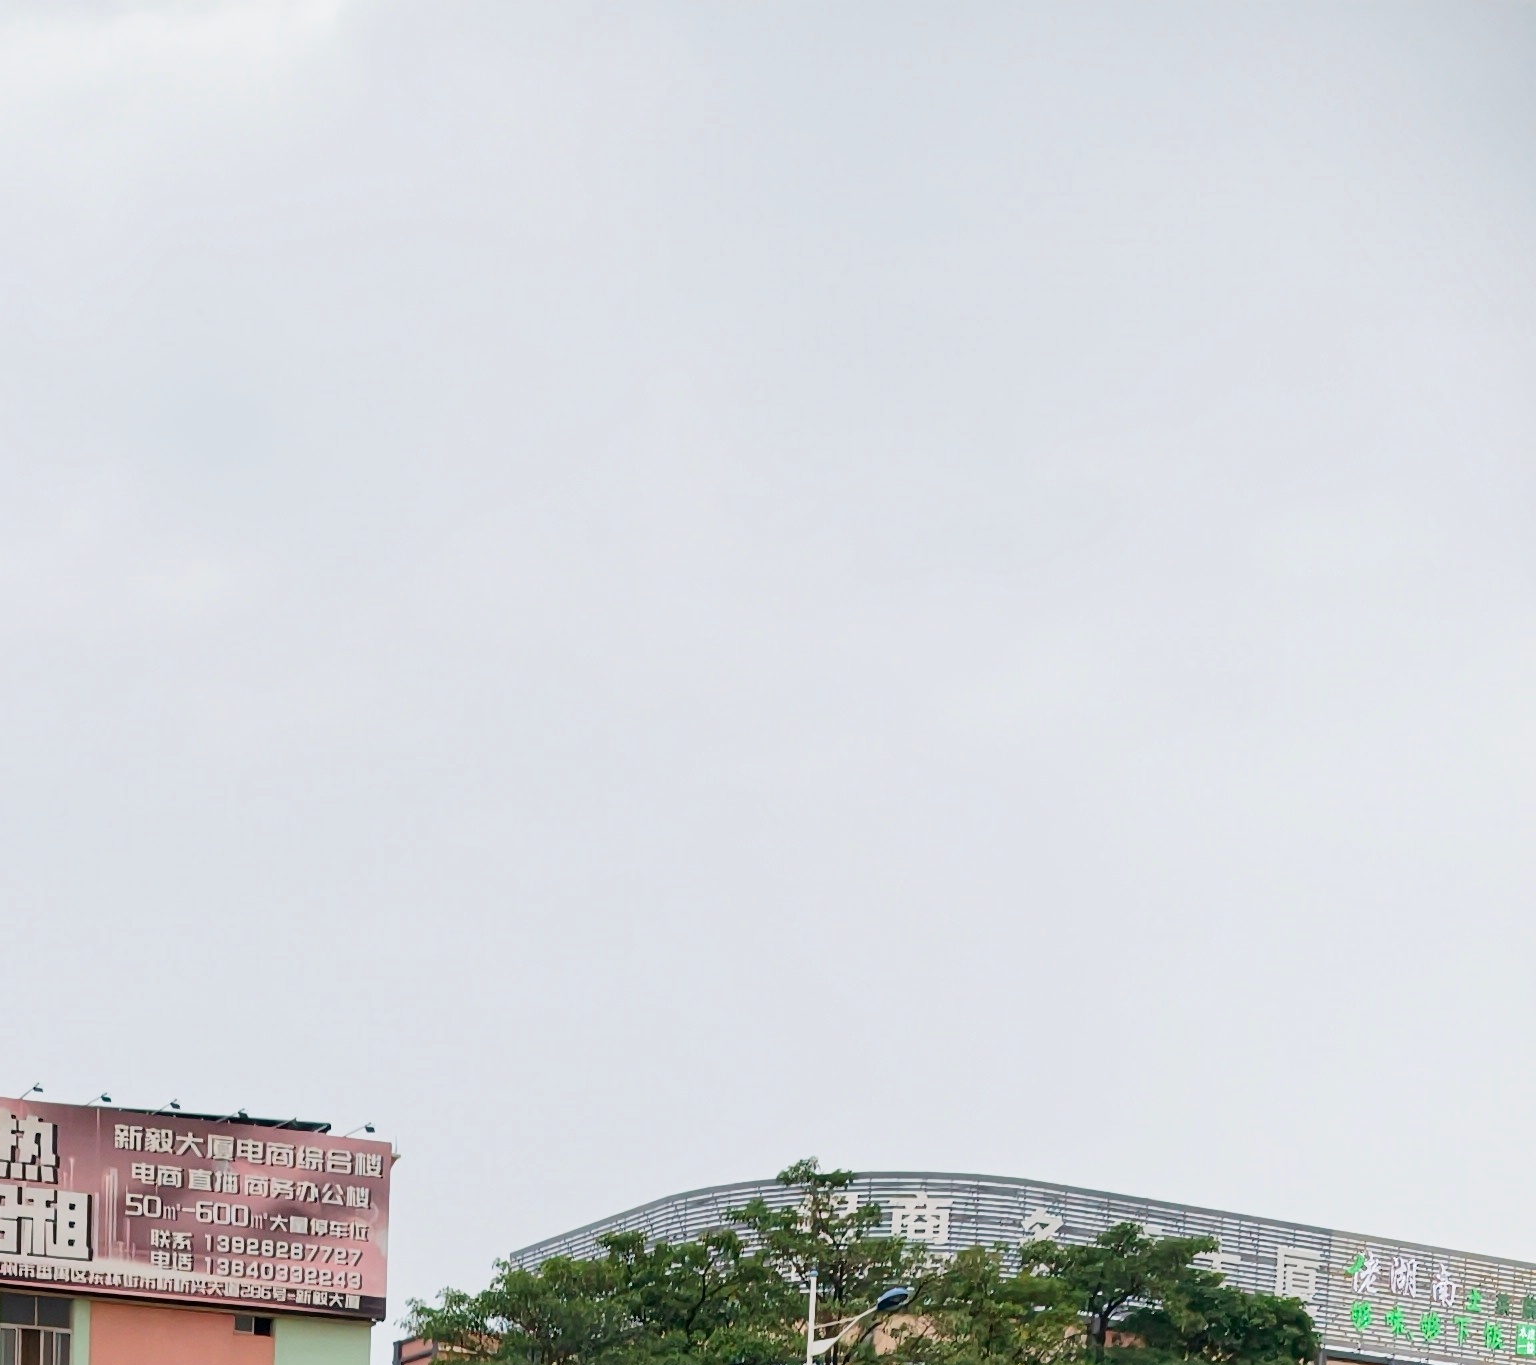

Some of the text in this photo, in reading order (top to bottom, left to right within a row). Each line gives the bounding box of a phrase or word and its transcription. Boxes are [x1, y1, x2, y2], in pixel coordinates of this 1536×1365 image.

[114, 1124, 383, 1179] 新毅大厦电商综合楼
[131, 1163, 183, 1189] 电商
[244, 1174, 371, 1209] 商务办公楼
[150, 1228, 194, 1251] 联系
[150, 1251, 194, 1272] 电话
